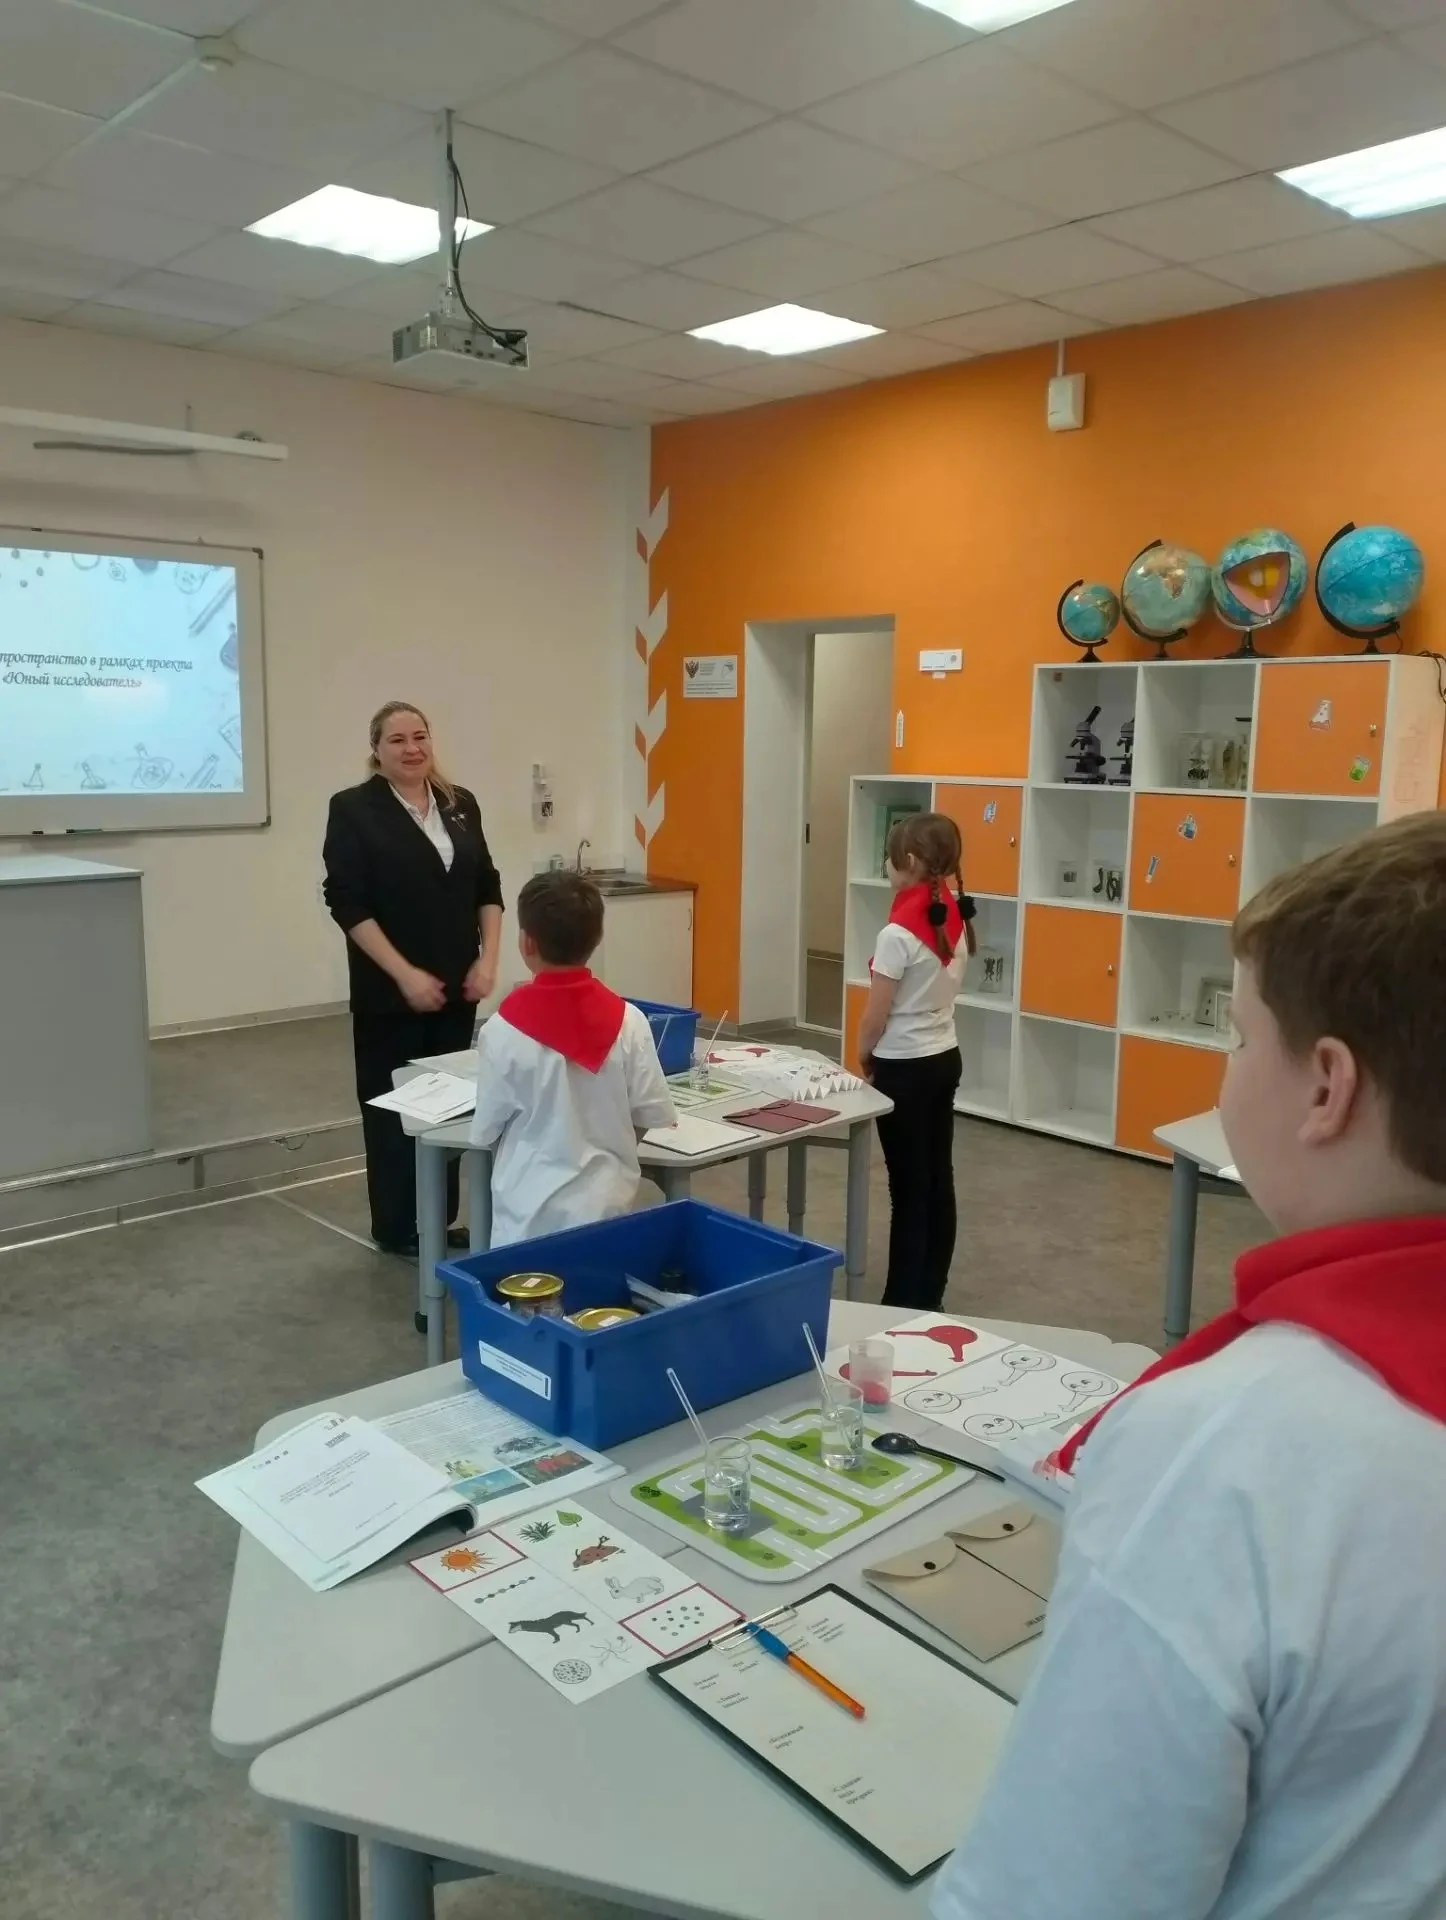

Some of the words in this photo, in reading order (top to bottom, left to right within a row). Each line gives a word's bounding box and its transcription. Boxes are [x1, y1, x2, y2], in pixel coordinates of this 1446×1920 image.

[90, 656, 96, 666] в
[98, 656, 144, 670] рамках
[146, 659, 193, 672] проекта
[2, 671, 50, 686] «Юный
[53, 672, 142, 688] исследователь»
